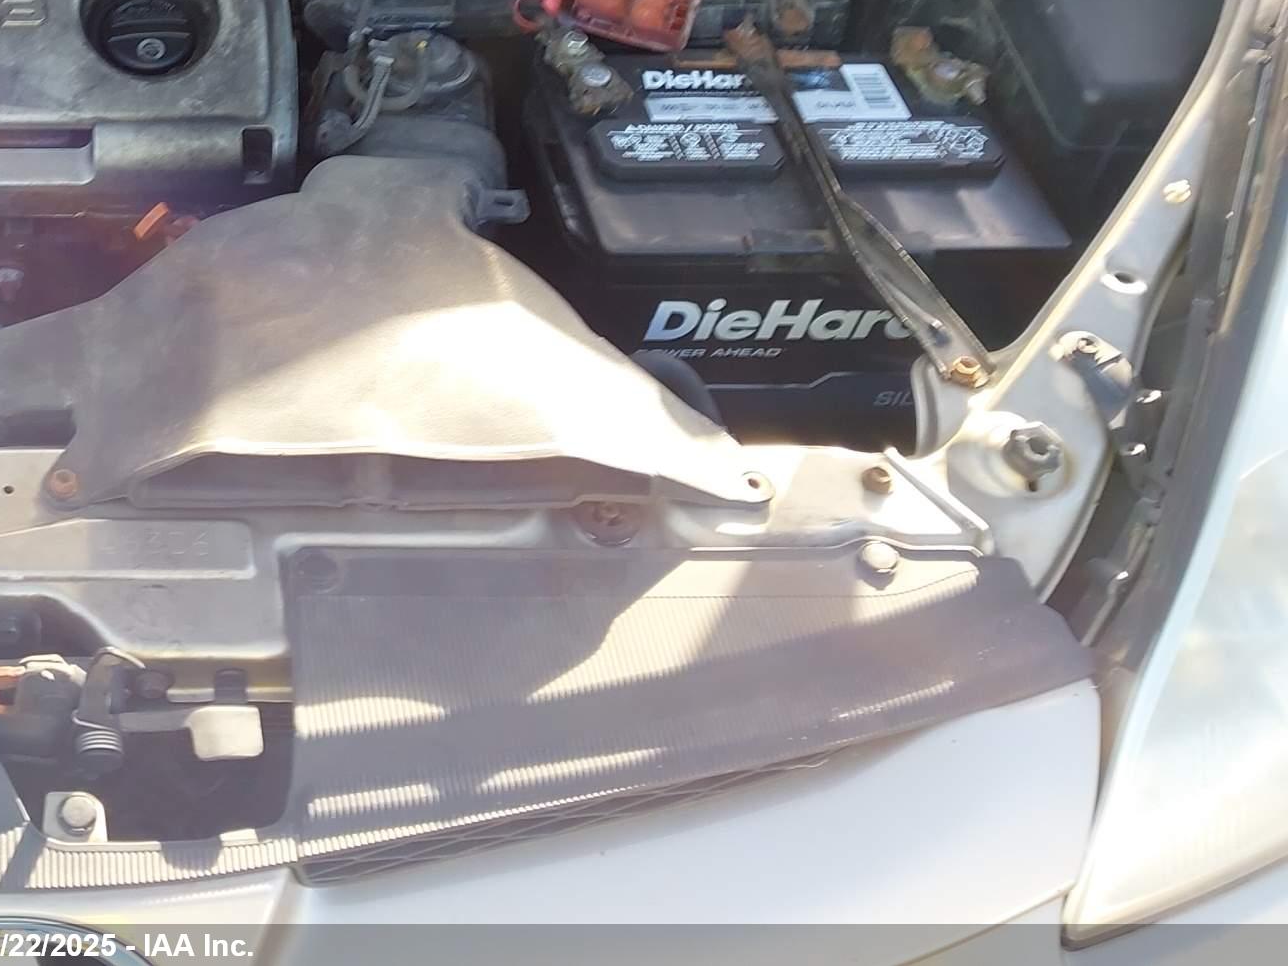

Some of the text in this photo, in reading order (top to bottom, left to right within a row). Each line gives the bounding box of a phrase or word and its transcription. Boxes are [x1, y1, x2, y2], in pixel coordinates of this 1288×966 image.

[642, 69, 752, 90] DieHar
[710, 347, 783, 359] AHEAD
[873, 390, 914, 408] SIL
